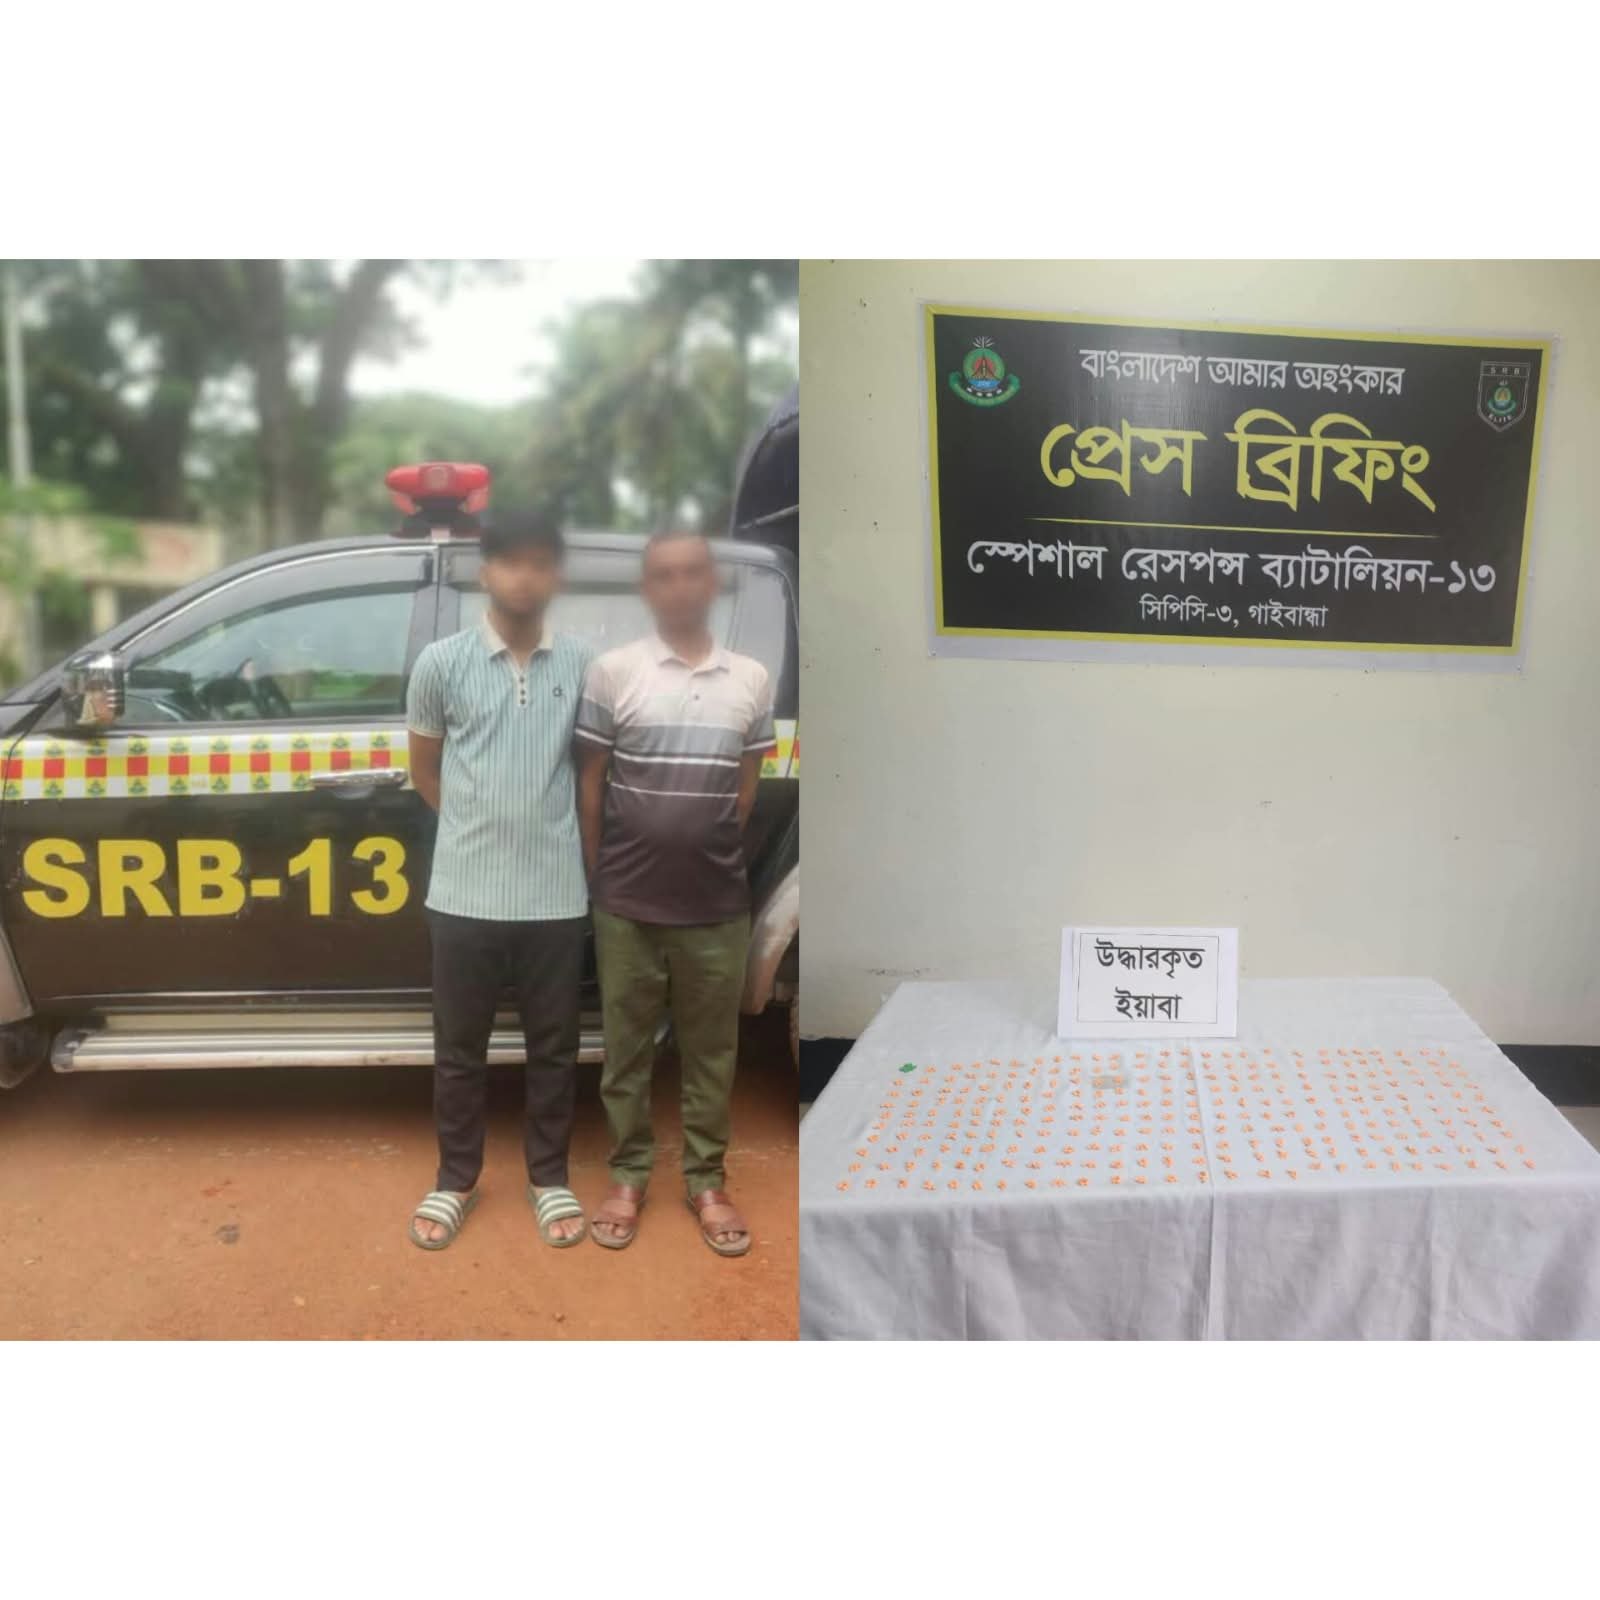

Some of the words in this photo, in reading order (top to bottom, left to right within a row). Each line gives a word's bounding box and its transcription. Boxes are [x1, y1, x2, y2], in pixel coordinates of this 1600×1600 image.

[1079, 348, 1202, 385] বাংলাদেশ
[1206, 356, 1289, 389] আমার
[1293, 361, 1406, 395] অহংকার
[1040, 418, 1206, 496] প্রেস
[1226, 409, 1436, 512] ব্রিফিং
[967, 538, 1108, 580] স্পেশাল
[1121, 547, 1250, 585] রেসপন্স
[1258, 543, 1497, 594] ব্যাটালিয়ন-১৩
[1138, 592, 1240, 628] সিপিসি-৩,
[1247, 598, 1329, 628] গাইবান্ধা
[22, 837, 409, 918] SRB-13
[1094, 937, 1206, 978] উদ্ধারকৃত
[1114, 986, 1182, 1020] ইয়াবা
